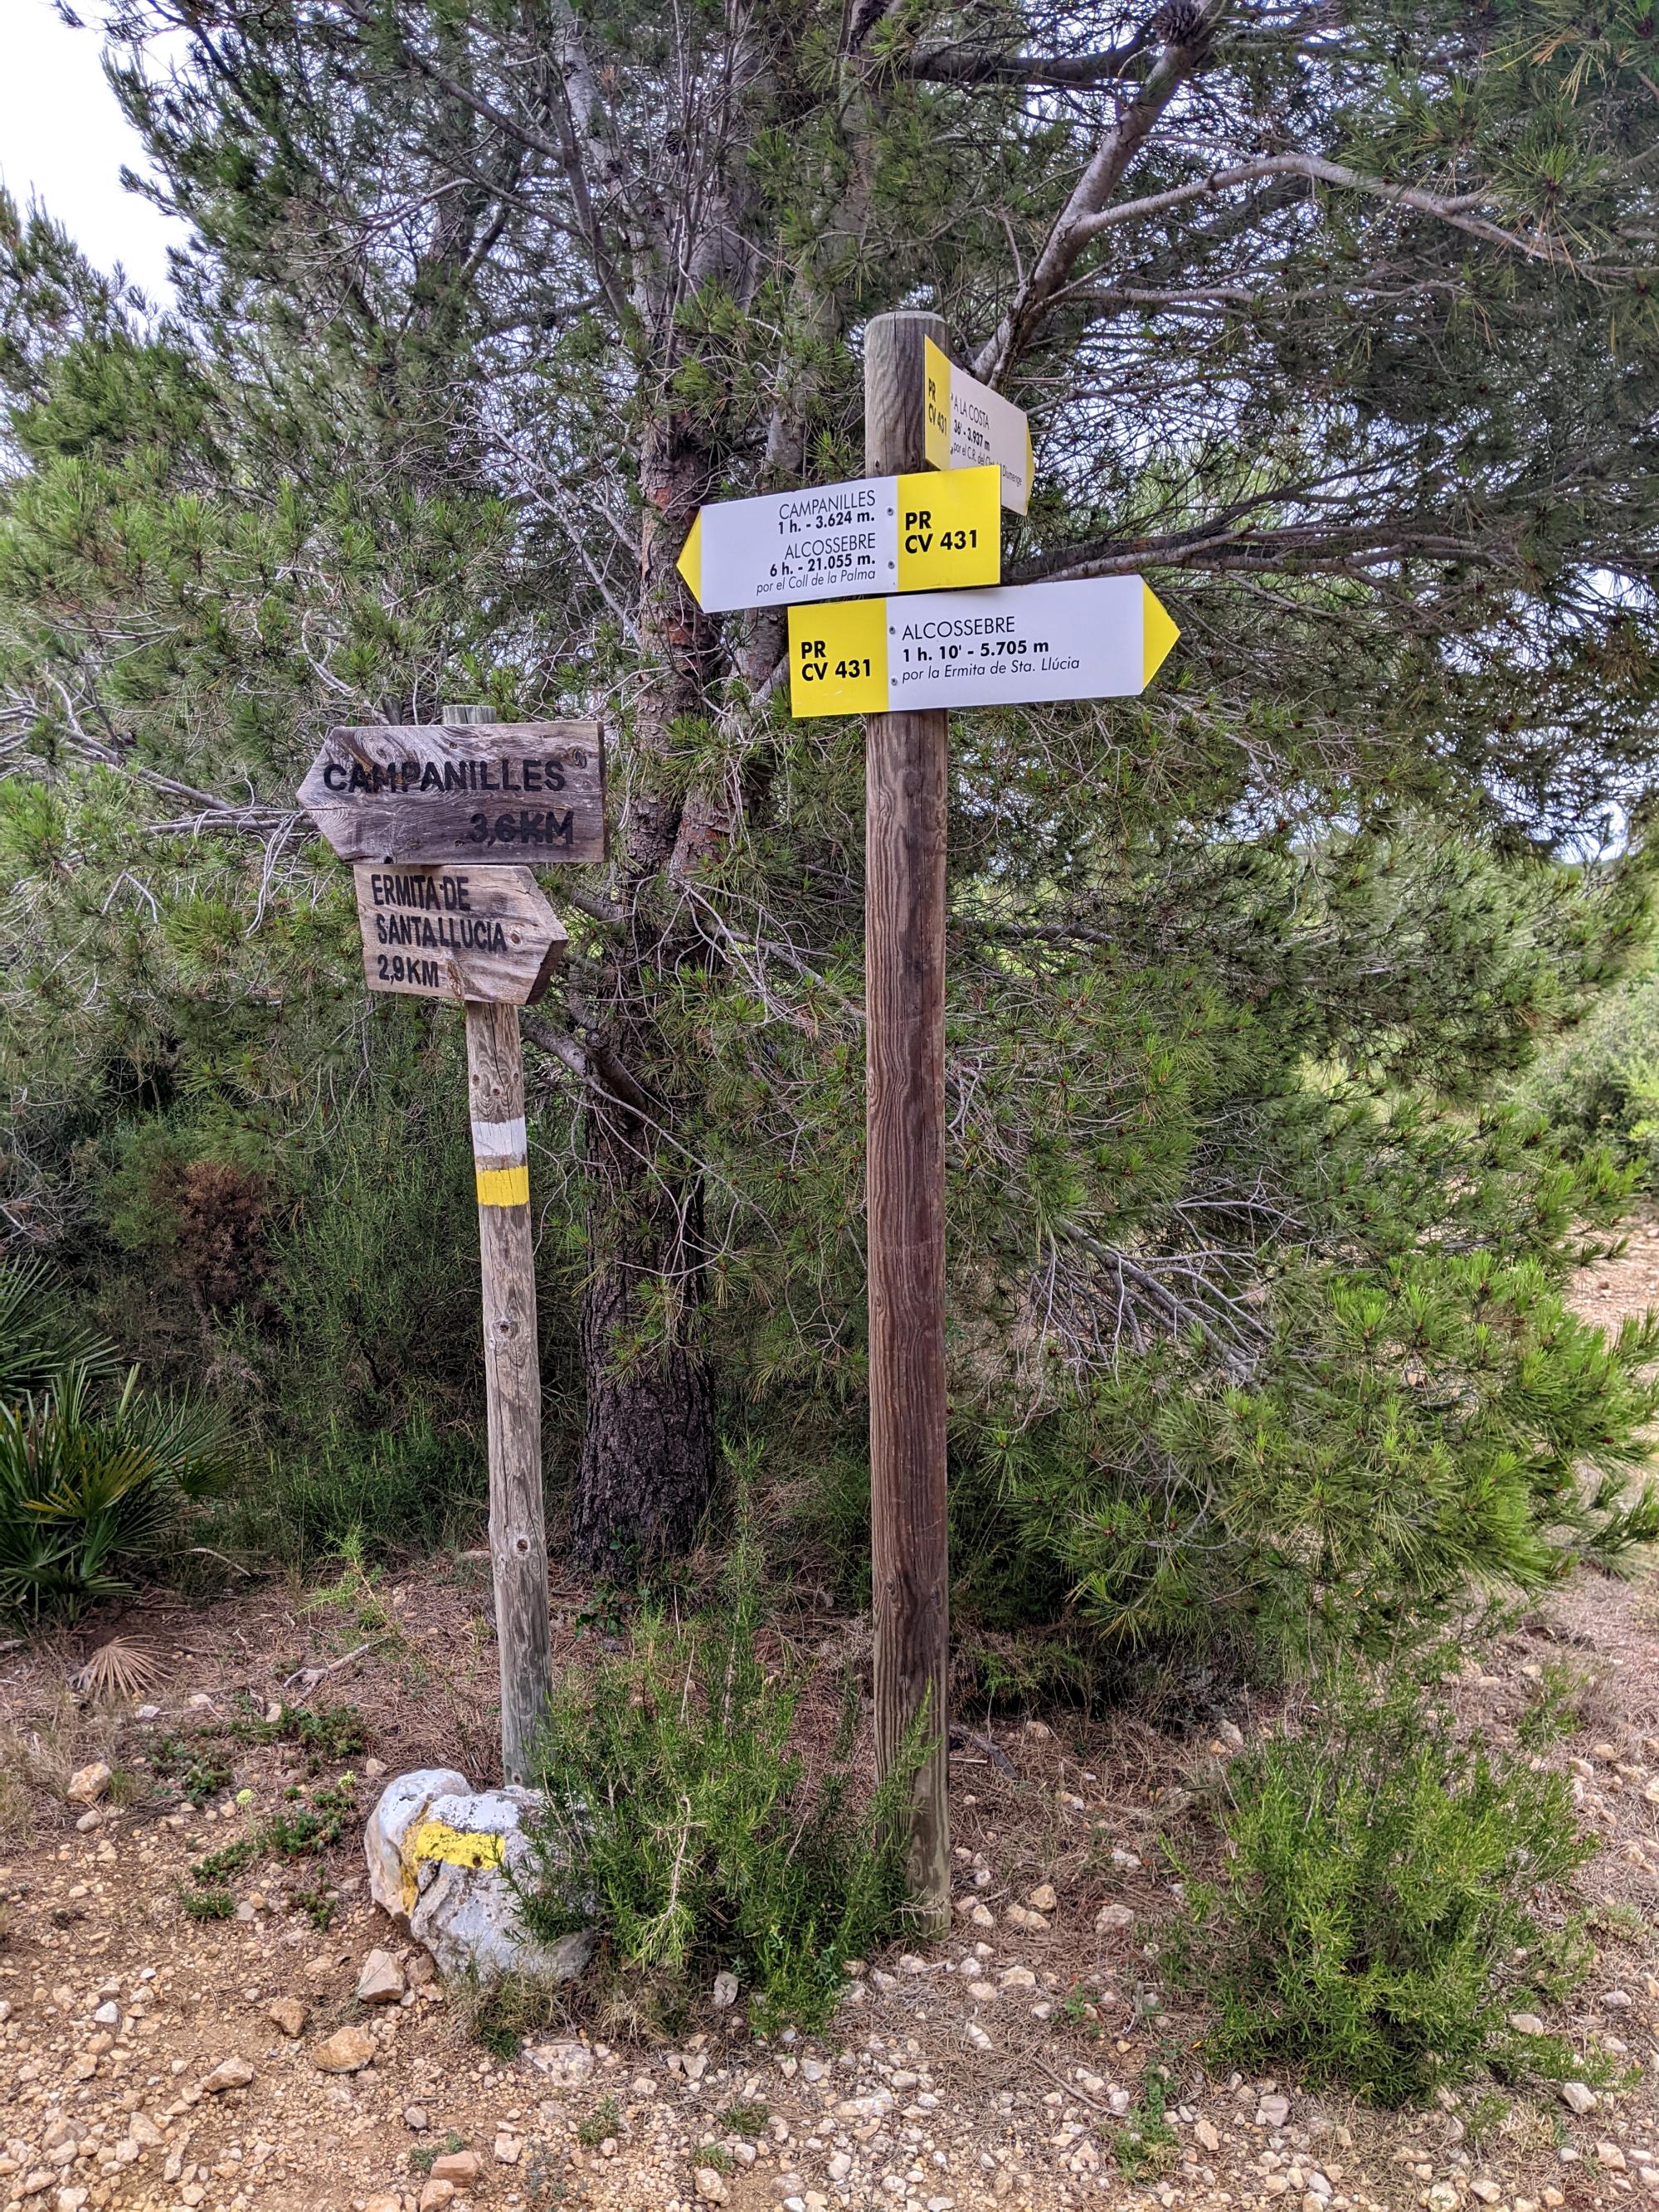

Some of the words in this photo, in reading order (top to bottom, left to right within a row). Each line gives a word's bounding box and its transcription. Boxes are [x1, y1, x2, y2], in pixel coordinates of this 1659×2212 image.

[928, 377, 937, 402] PR
[928, 403, 937, 425] CV
[937, 411, 947, 436] 431
[954, 396, 959, 412] A
[960, 398, 968, 418] LA
[969, 404, 990, 430] COSTA
[962, 444, 967, 456] el
[967, 427, 984, 447] 3.937
[985, 440, 990, 452] m
[779, 489, 876, 520] CAMPANILLES
[778, 521, 784, 535] 1
[789, 519, 801, 533] h.
[815, 510, 853, 529] 3.624
[857, 511, 875, 523] m.
[905, 511, 932, 531] PR
[784, 532, 876, 560] ALCOSSEBRE
[905, 533, 933, 554] CV
[940, 529, 979, 551] 431
[770, 563, 778, 577] 6
[781, 562, 794, 576] h.
[807, 553, 853, 572] 21.055
[857, 554, 876, 566] m.
[756, 582, 774, 596] por
[776, 577, 786, 591] el
[788, 574, 809, 589] Coll
[810, 572, 825, 586] de
[827, 571, 838, 584] la
[840, 567, 876, 582] Palma
[902, 616, 1016, 641] ALCOSSEBRE
[800, 640, 827, 659] PR
[903, 648, 910, 663] 1
[917, 646, 933, 662] h.
[939, 644, 962, 660] 10'
[980, 639, 1028, 658] 5.705
[1034, 641, 1049, 653] m
[801, 662, 829, 682] CV
[834, 659, 872, 678] 431
[902, 670, 925, 684] por
[928, 665, 940, 679] la
[944, 663, 986, 678] Ermita
[990, 660, 1007, 674] de
[1010, 659, 1036, 673] Sta.
[1041, 656, 1080, 672] Llúcia
[323, 758, 567, 794] CAMPANILLES
[371, 873, 441, 911] ERMITA
[442, 876, 471, 912] DE
